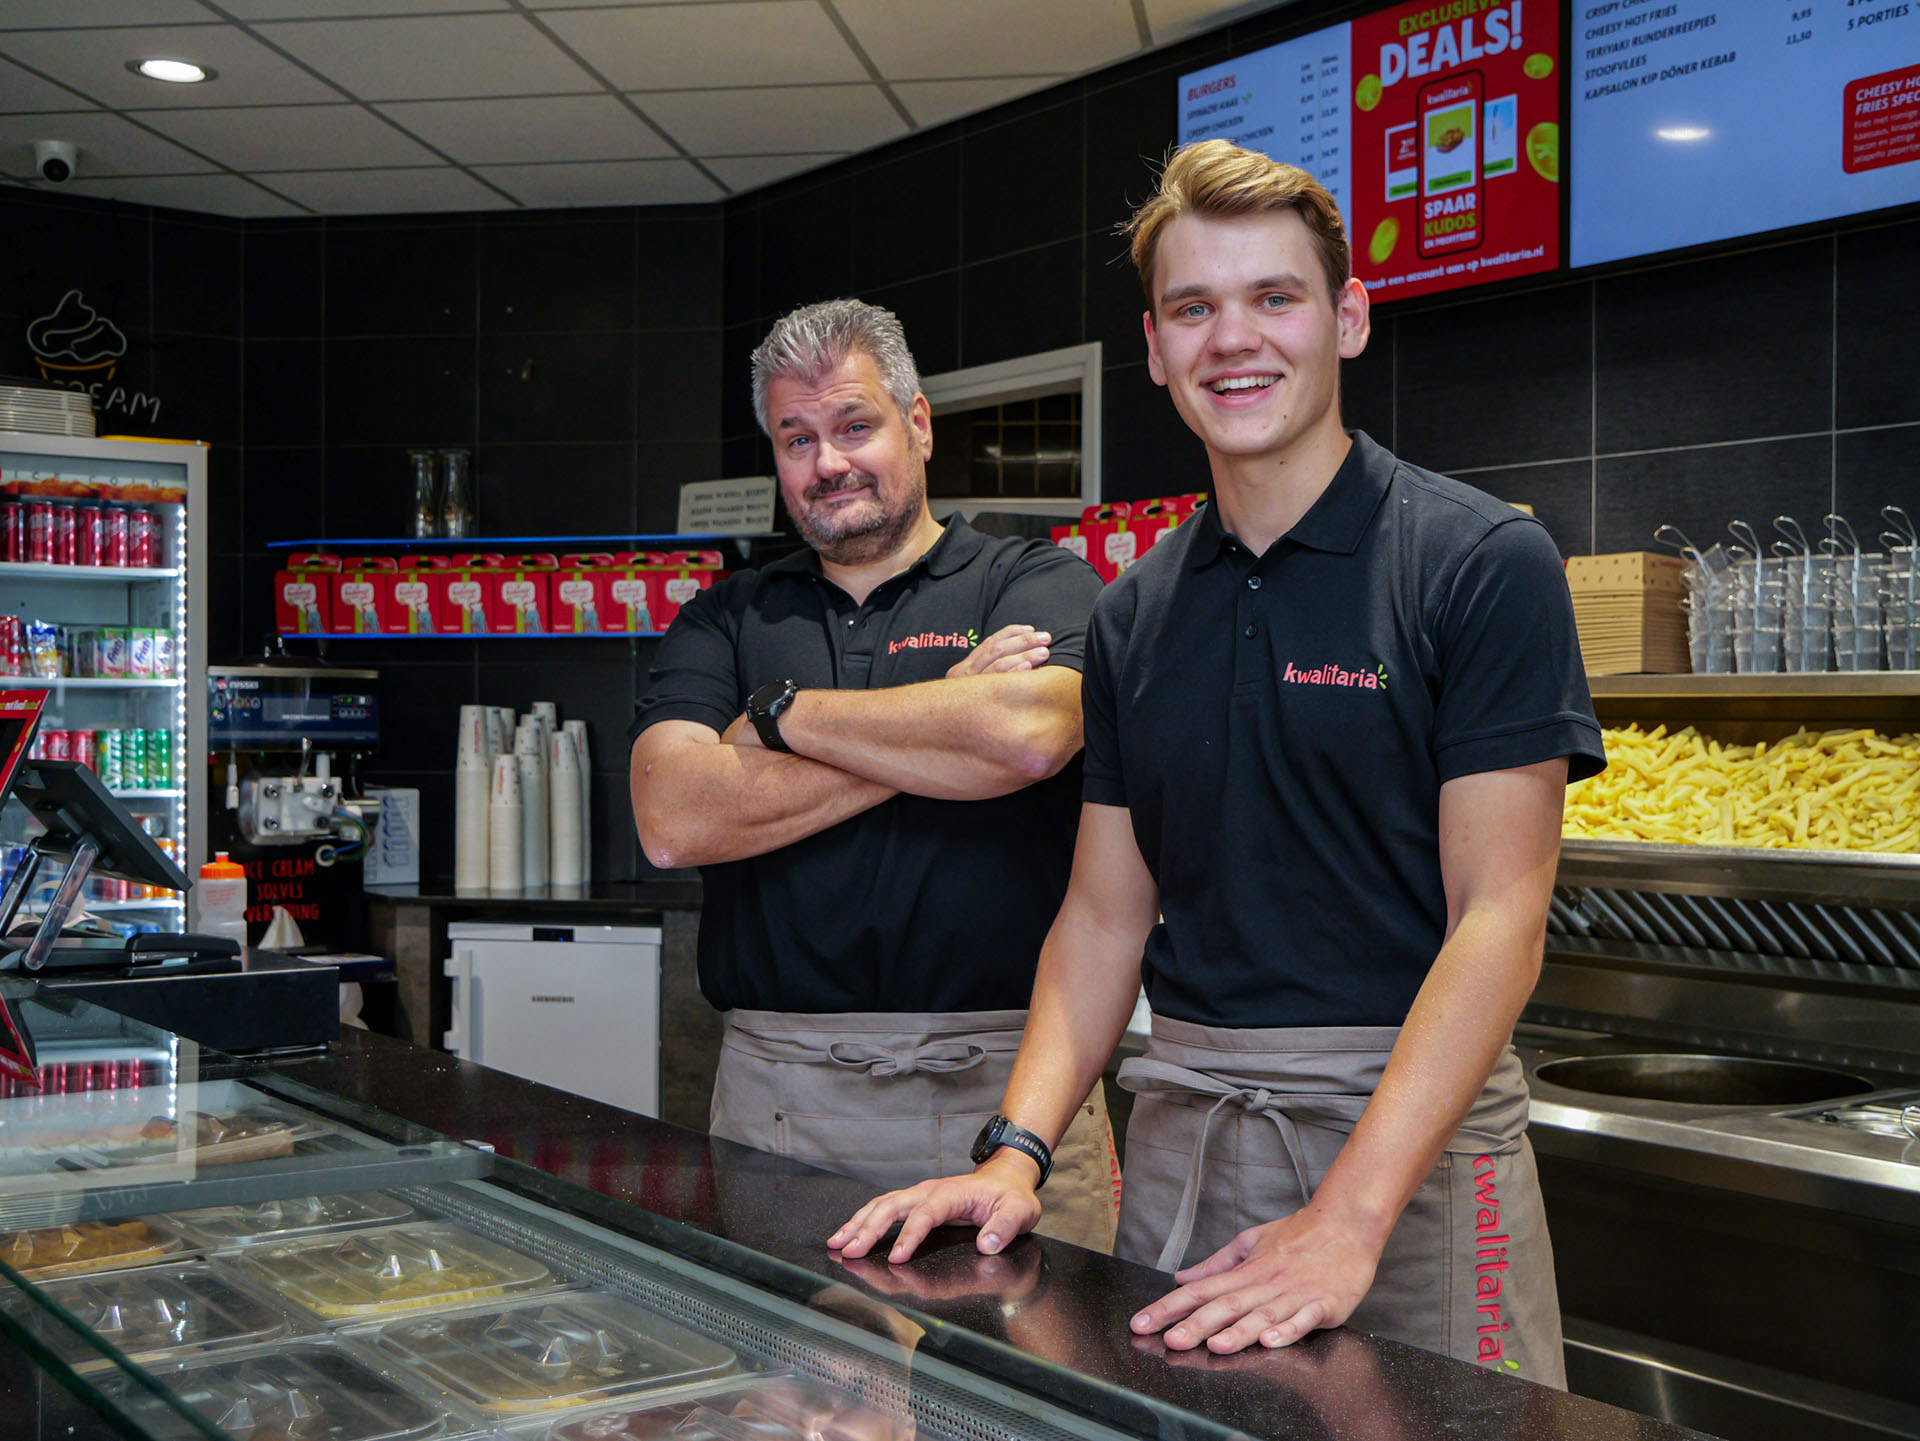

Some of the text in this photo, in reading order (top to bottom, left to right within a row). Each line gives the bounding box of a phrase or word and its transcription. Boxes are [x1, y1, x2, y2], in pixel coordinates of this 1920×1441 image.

[1585, 1, 1619, 20] CRISPY
[1585, 20, 1622, 40] CHEESY
[1624, 13, 1647, 29] HOT
[1649, 4, 1678, 21] FRIES
[1857, 3, 1910, 27] PORTIES
[1380, 0, 1523, 87] DEALS!
[1586, 14, 1716, 60] TERIYAKI RUNDERREEPJES
[1584, 77, 1638, 100] KAPSALON
[1640, 71, 1659, 86] KIP
[1700, 51, 1736, 70] KEBAB
[1585, 54, 1648, 80] STOOFVLEES
[1187, 74, 1236, 101] BURGERS
[1856, 80, 1903, 102] CHEESY
[1855, 97, 1889, 116] FRIES
[1424, 192, 1476, 219] SPAAR
[1424, 212, 1476, 237] KUDOS
[1406, 265, 1444, 283] account
[1466, 260, 1479, 273] op
[53, 379, 161, 423] EAM
[888, 632, 968, 655] kwalitaria
[1283, 662, 1378, 689] kwalitaria
[272, 858, 315, 878] CREAM
[257, 882, 303, 900] SOLVES
[247, 904, 319, 923] VERHING
